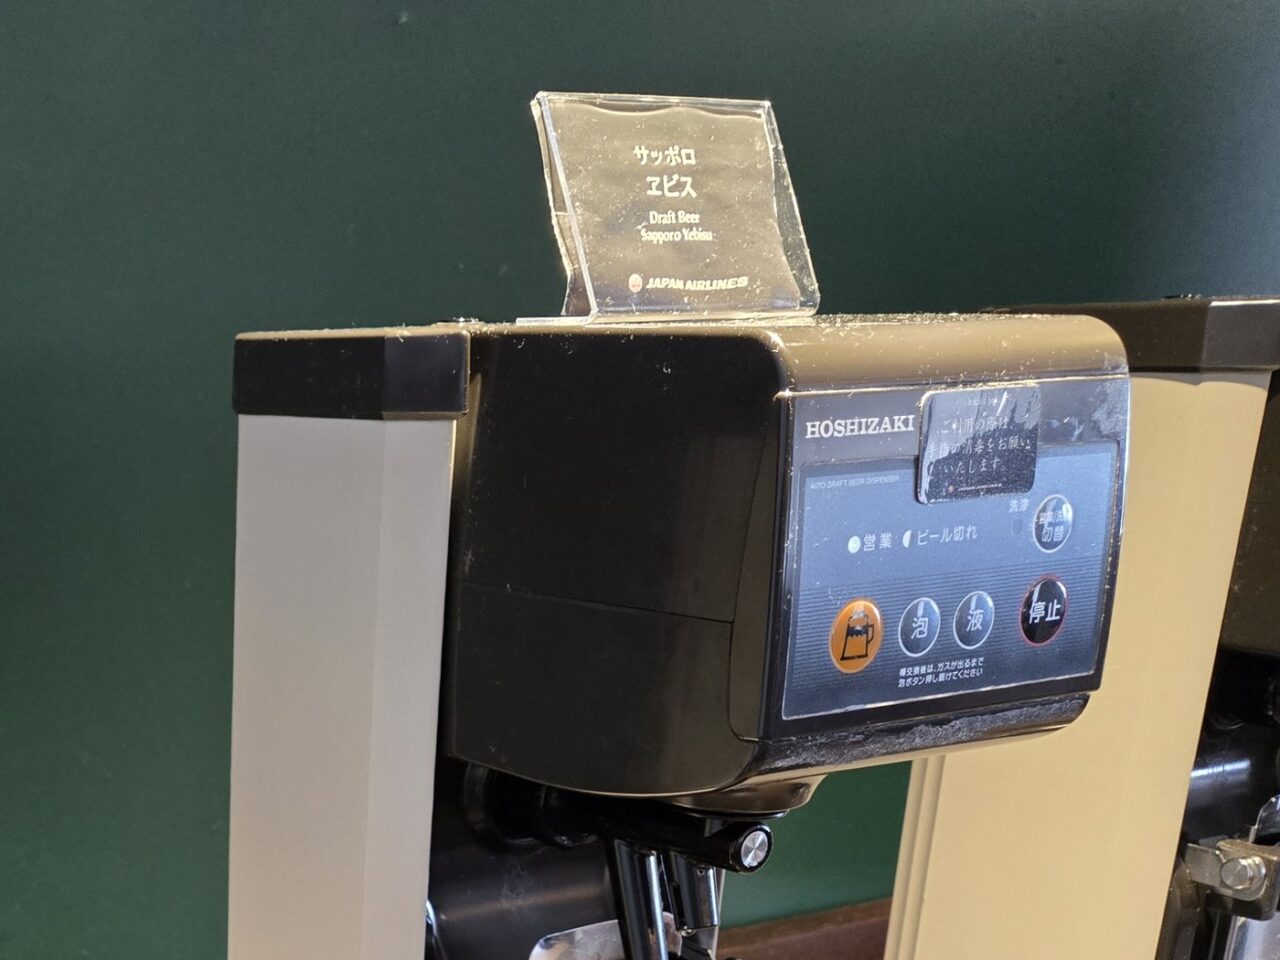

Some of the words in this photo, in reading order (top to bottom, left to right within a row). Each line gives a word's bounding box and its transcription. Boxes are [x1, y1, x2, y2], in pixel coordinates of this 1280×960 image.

[632, 144, 697, 166] サッポロ
[649, 210, 678, 225] Draft
[679, 210, 700, 224] Beer
[640, 228, 681, 244] Sapporo
[682, 227, 713, 242] Yebisu
[645, 276, 684, 290] JAPAN
[684, 275, 749, 291] AIRLINES
[805, 414, 916, 439] HOSHIZAKI
[863, 532, 893, 552] 営業
[917, 525, 978, 546] ビール切れ
[966, 608, 985, 632] 液
[1028, 599, 1062, 625] 停止
[910, 616, 929, 640] 泡
